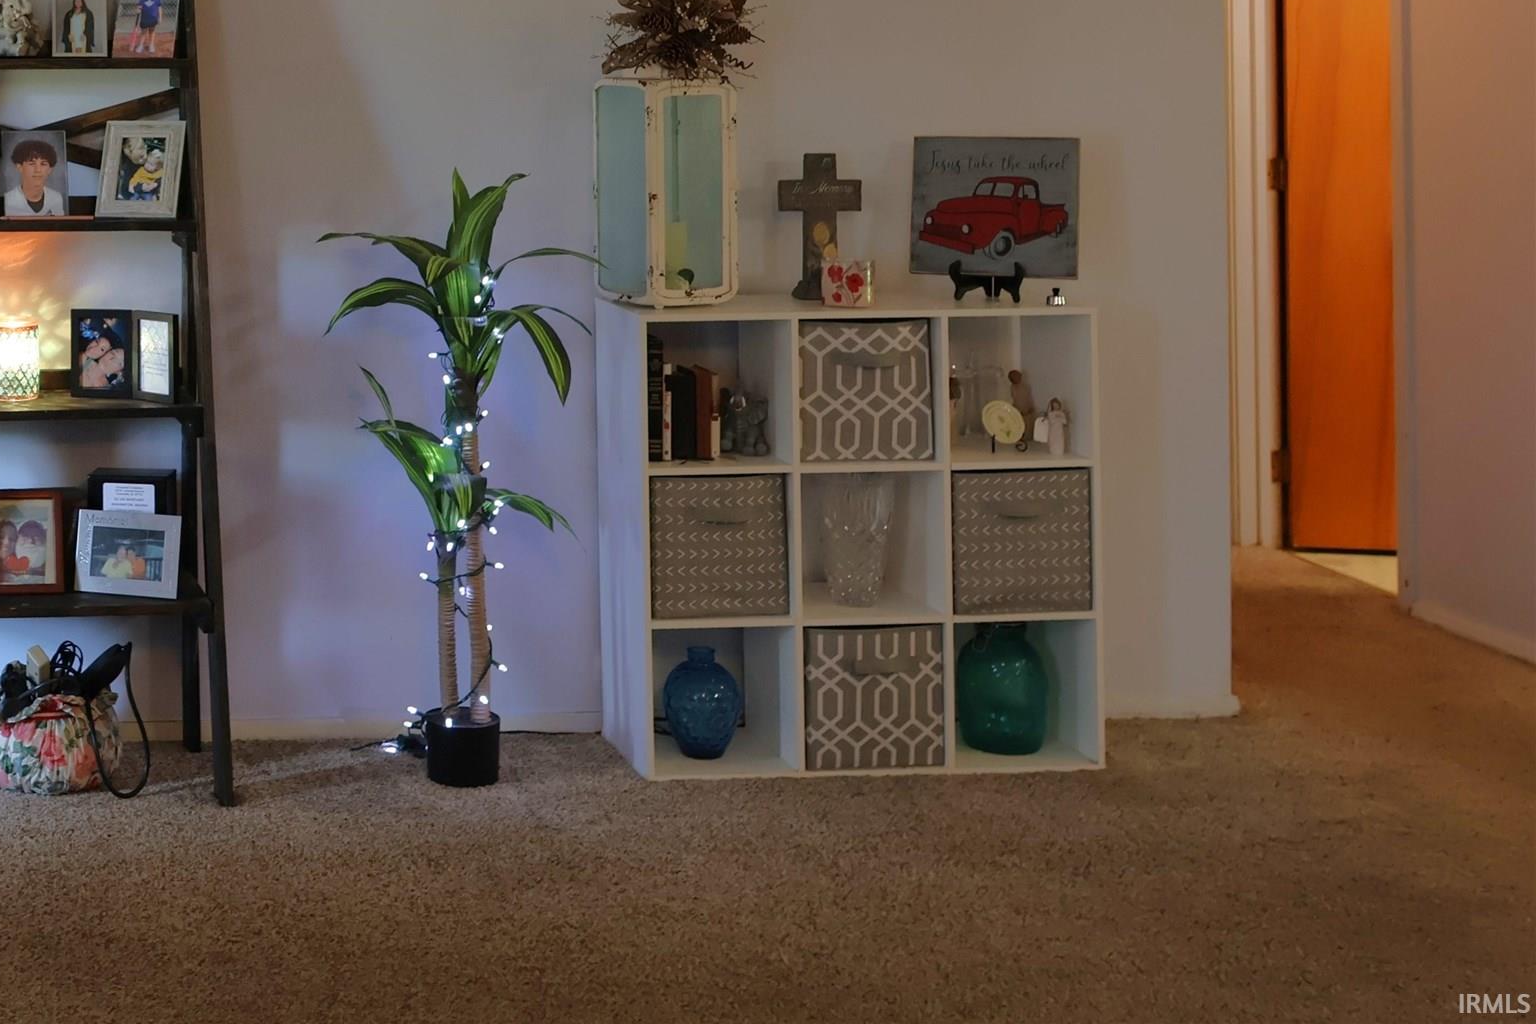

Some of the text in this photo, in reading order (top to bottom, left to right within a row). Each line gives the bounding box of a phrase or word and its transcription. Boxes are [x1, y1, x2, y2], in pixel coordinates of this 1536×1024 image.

[928, 149, 1070, 174] Jesus take the wheel
